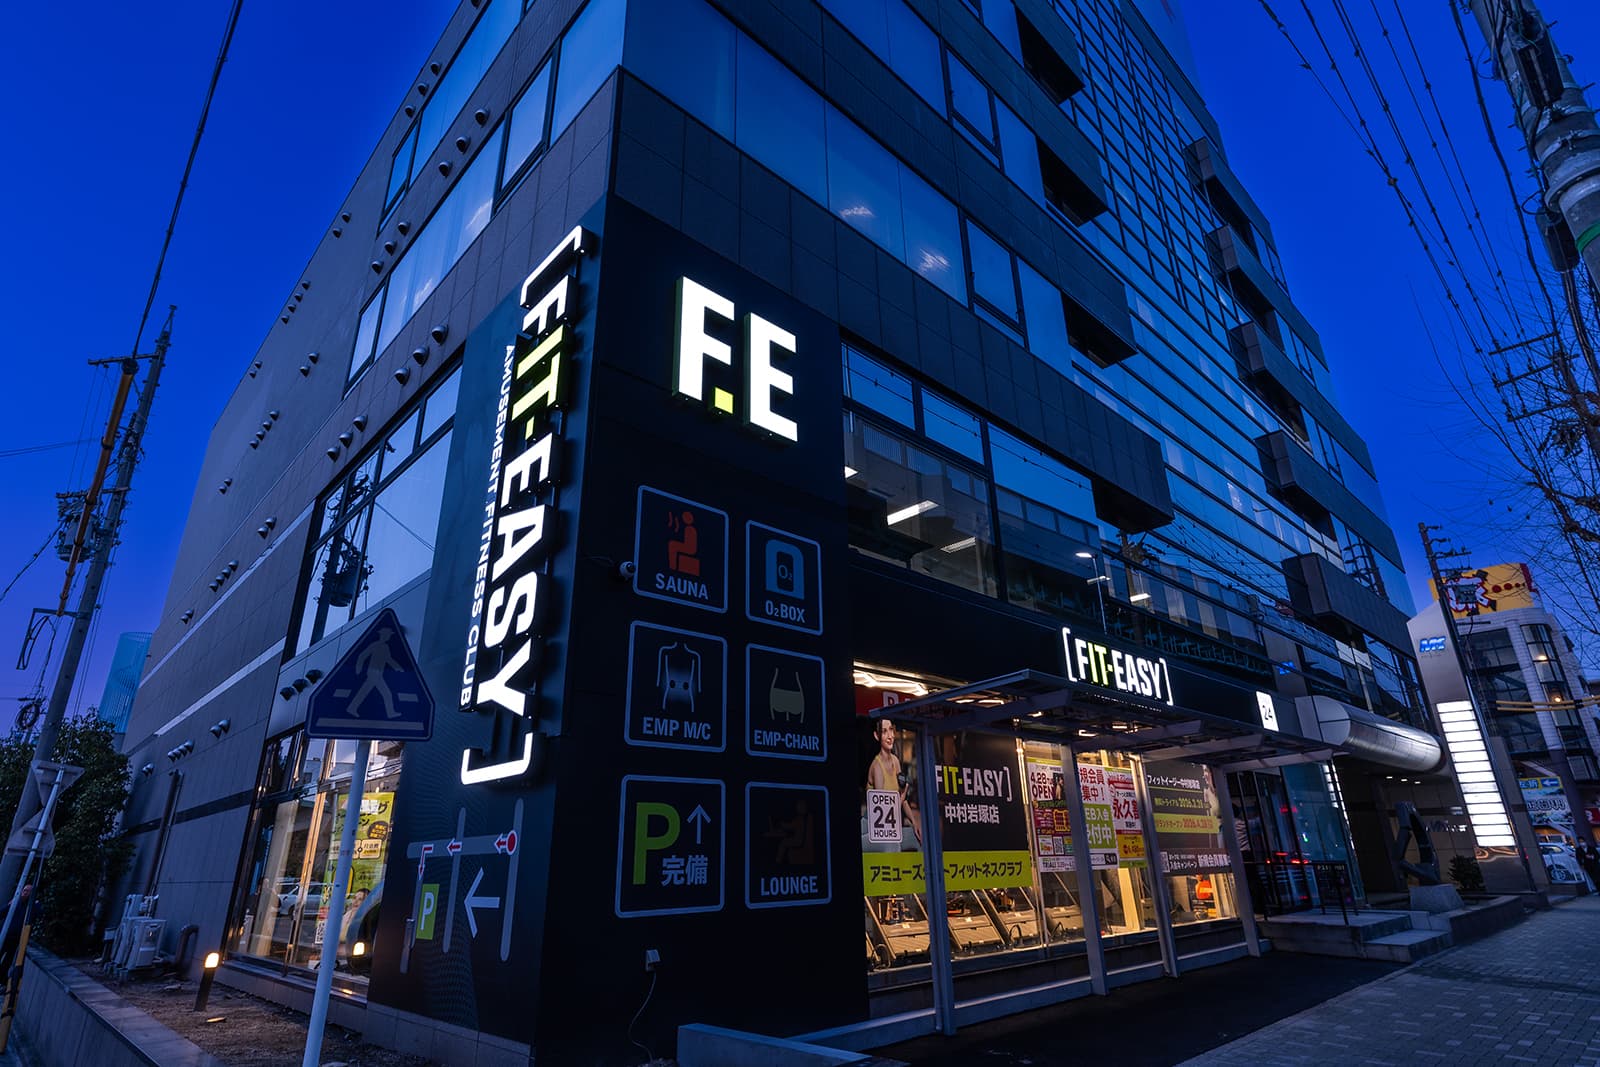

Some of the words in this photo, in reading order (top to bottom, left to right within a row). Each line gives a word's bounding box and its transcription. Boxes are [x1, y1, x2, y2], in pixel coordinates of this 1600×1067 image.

[487, 344, 516, 494] AMUSEMENT
[472, 501, 496, 618] FITNESS
[655, 573, 709, 600] SAUNA
[460, 624, 481, 706] CLUB
[1262, 704, 1274, 721] 24
[642, 717, 679, 737] EMP
[683, 721, 711, 741] M/C
[753, 729, 820, 752] EMP-CHAIR
[872, 794, 896, 805] OPEN
[1032, 785, 1056, 799] OPEN
[873, 806, 897, 829] 24
[945, 803, 1000, 824] 中村岩塚店
[632, 802, 681, 885] P
[873, 829, 897, 838] HOURS
[661, 855, 708, 887] 完備
[760, 875, 819, 897] LOUNGE
[420, 892, 434, 930] P
